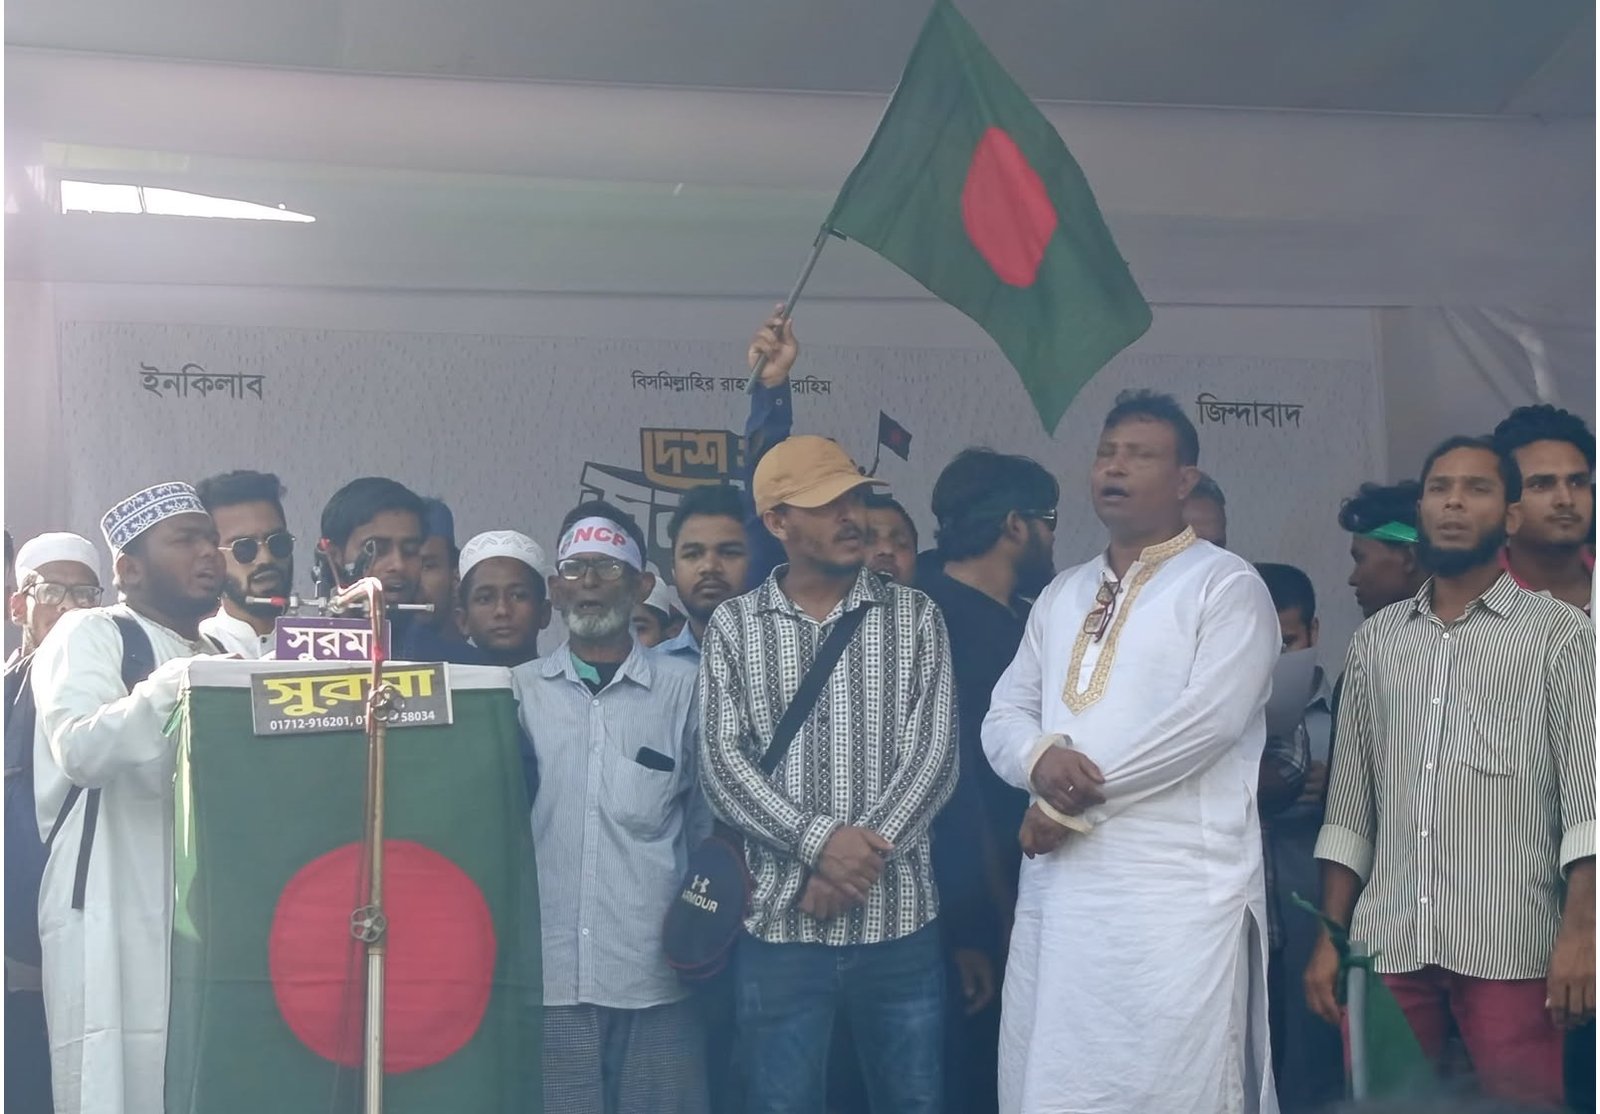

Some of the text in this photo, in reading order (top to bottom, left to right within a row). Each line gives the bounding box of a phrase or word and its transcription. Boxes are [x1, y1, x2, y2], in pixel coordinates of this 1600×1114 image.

[140, 362, 266, 400] ইনকিলাব
[631, 370, 715, 393] বিসমিল্লাহির
[1195, 393, 1304, 428] জিন্দাবাদ
[574, 527, 626, 546] NCP
[283, 627, 373, 661] সুরম
[270, 715, 353, 730] 01712-916201,
